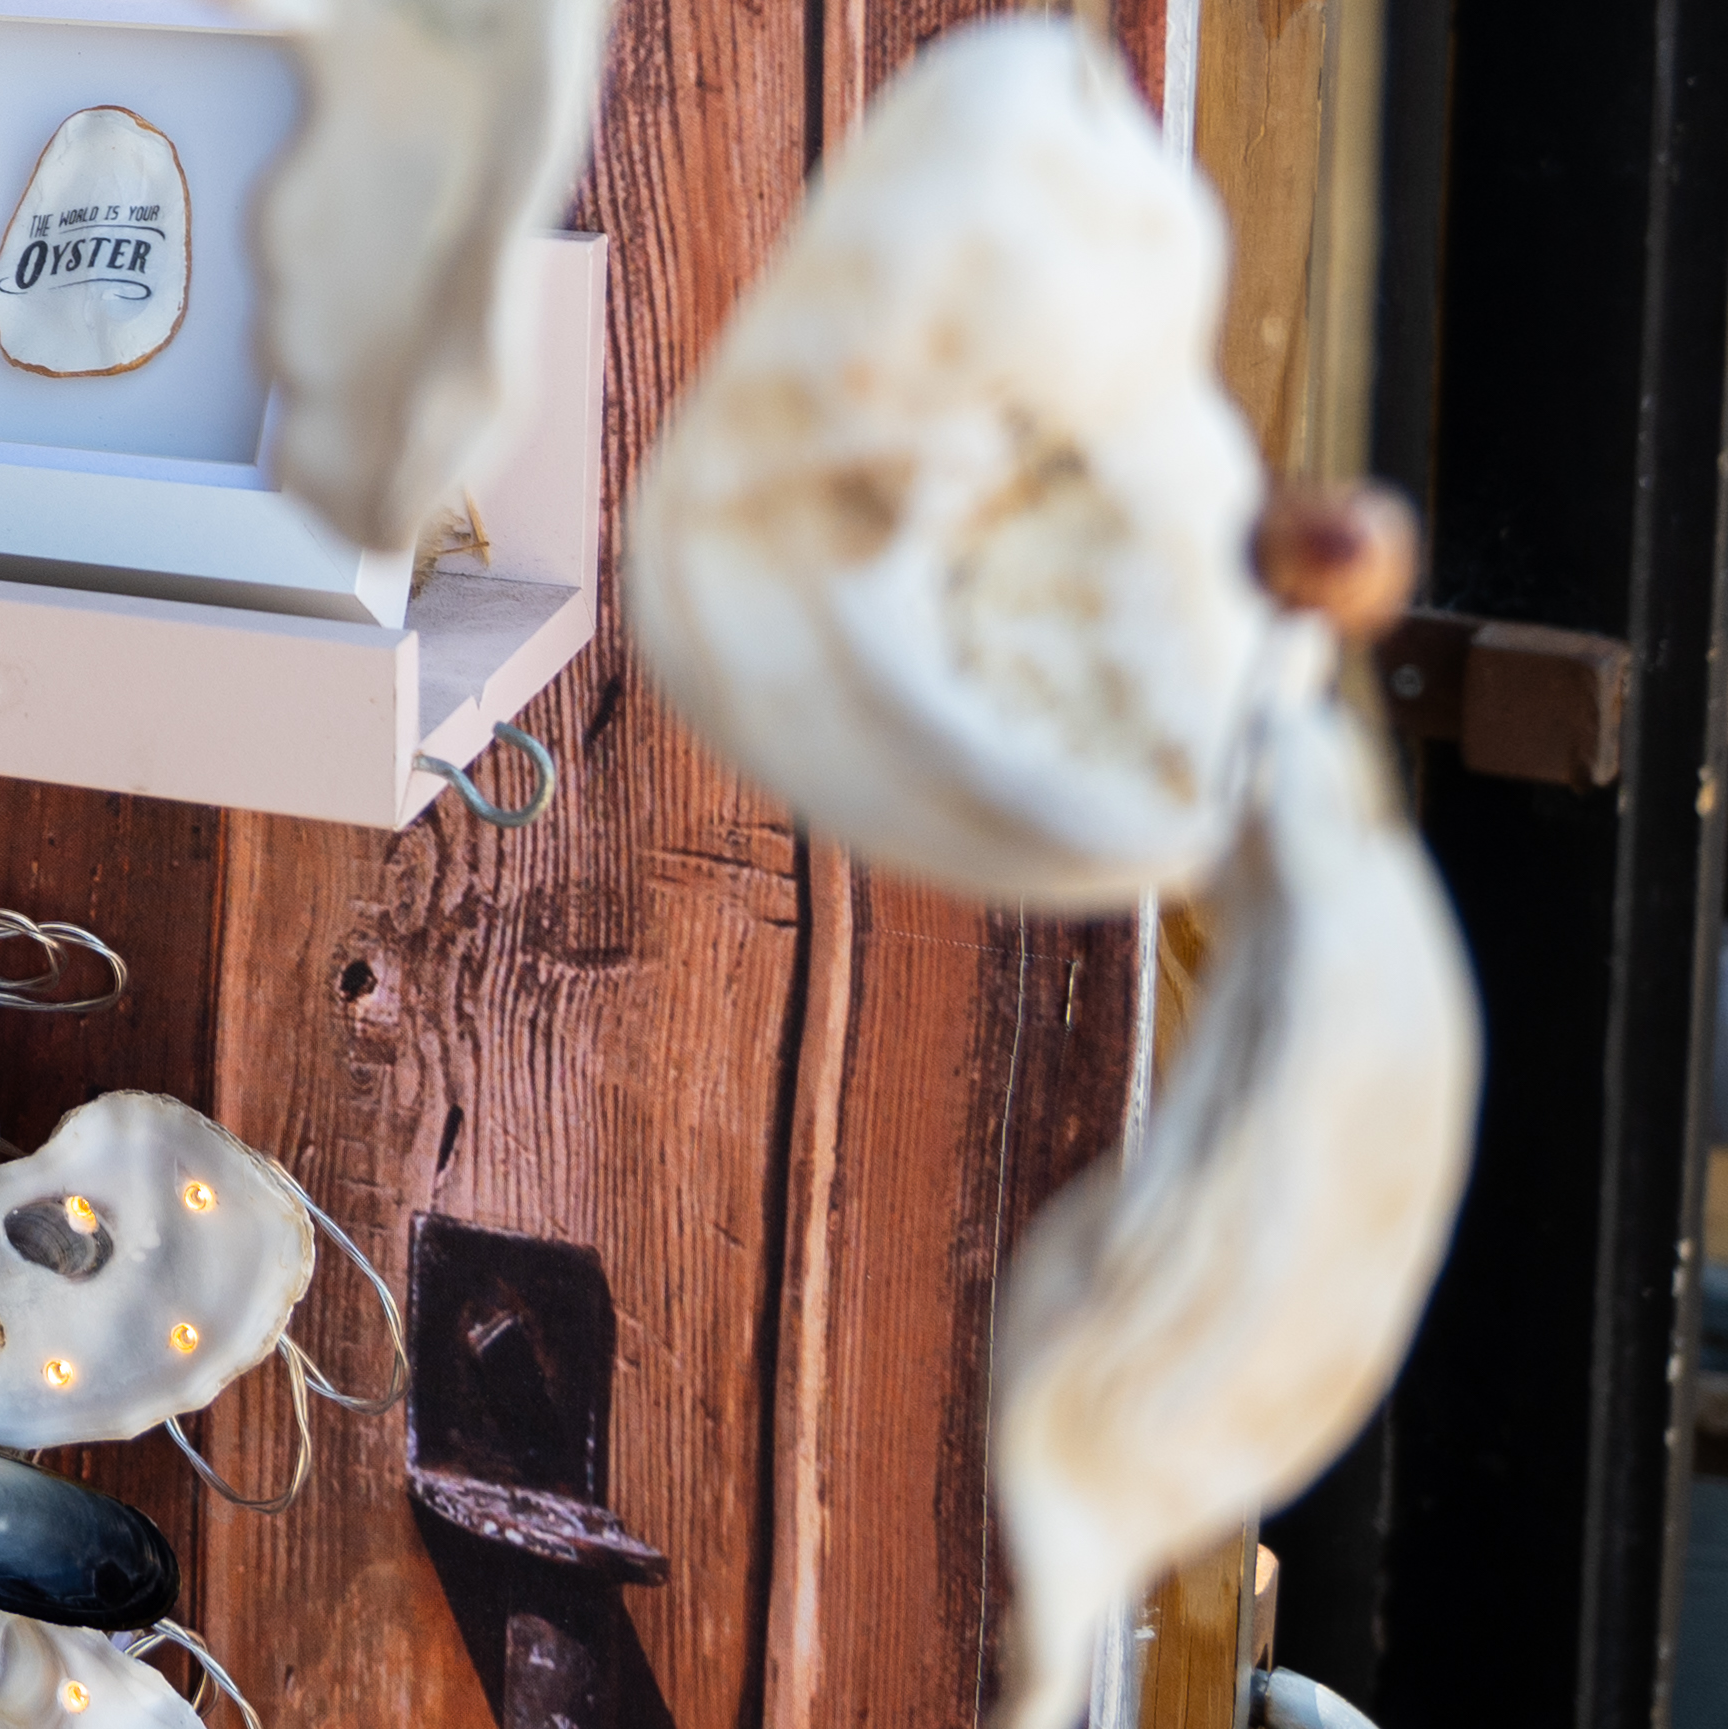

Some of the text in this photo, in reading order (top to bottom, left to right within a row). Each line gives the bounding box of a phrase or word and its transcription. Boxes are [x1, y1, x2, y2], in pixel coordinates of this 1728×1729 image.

[29, 205, 160, 238] THE WORLD IS YOUR
[15, 237, 152, 289] OYSTER
